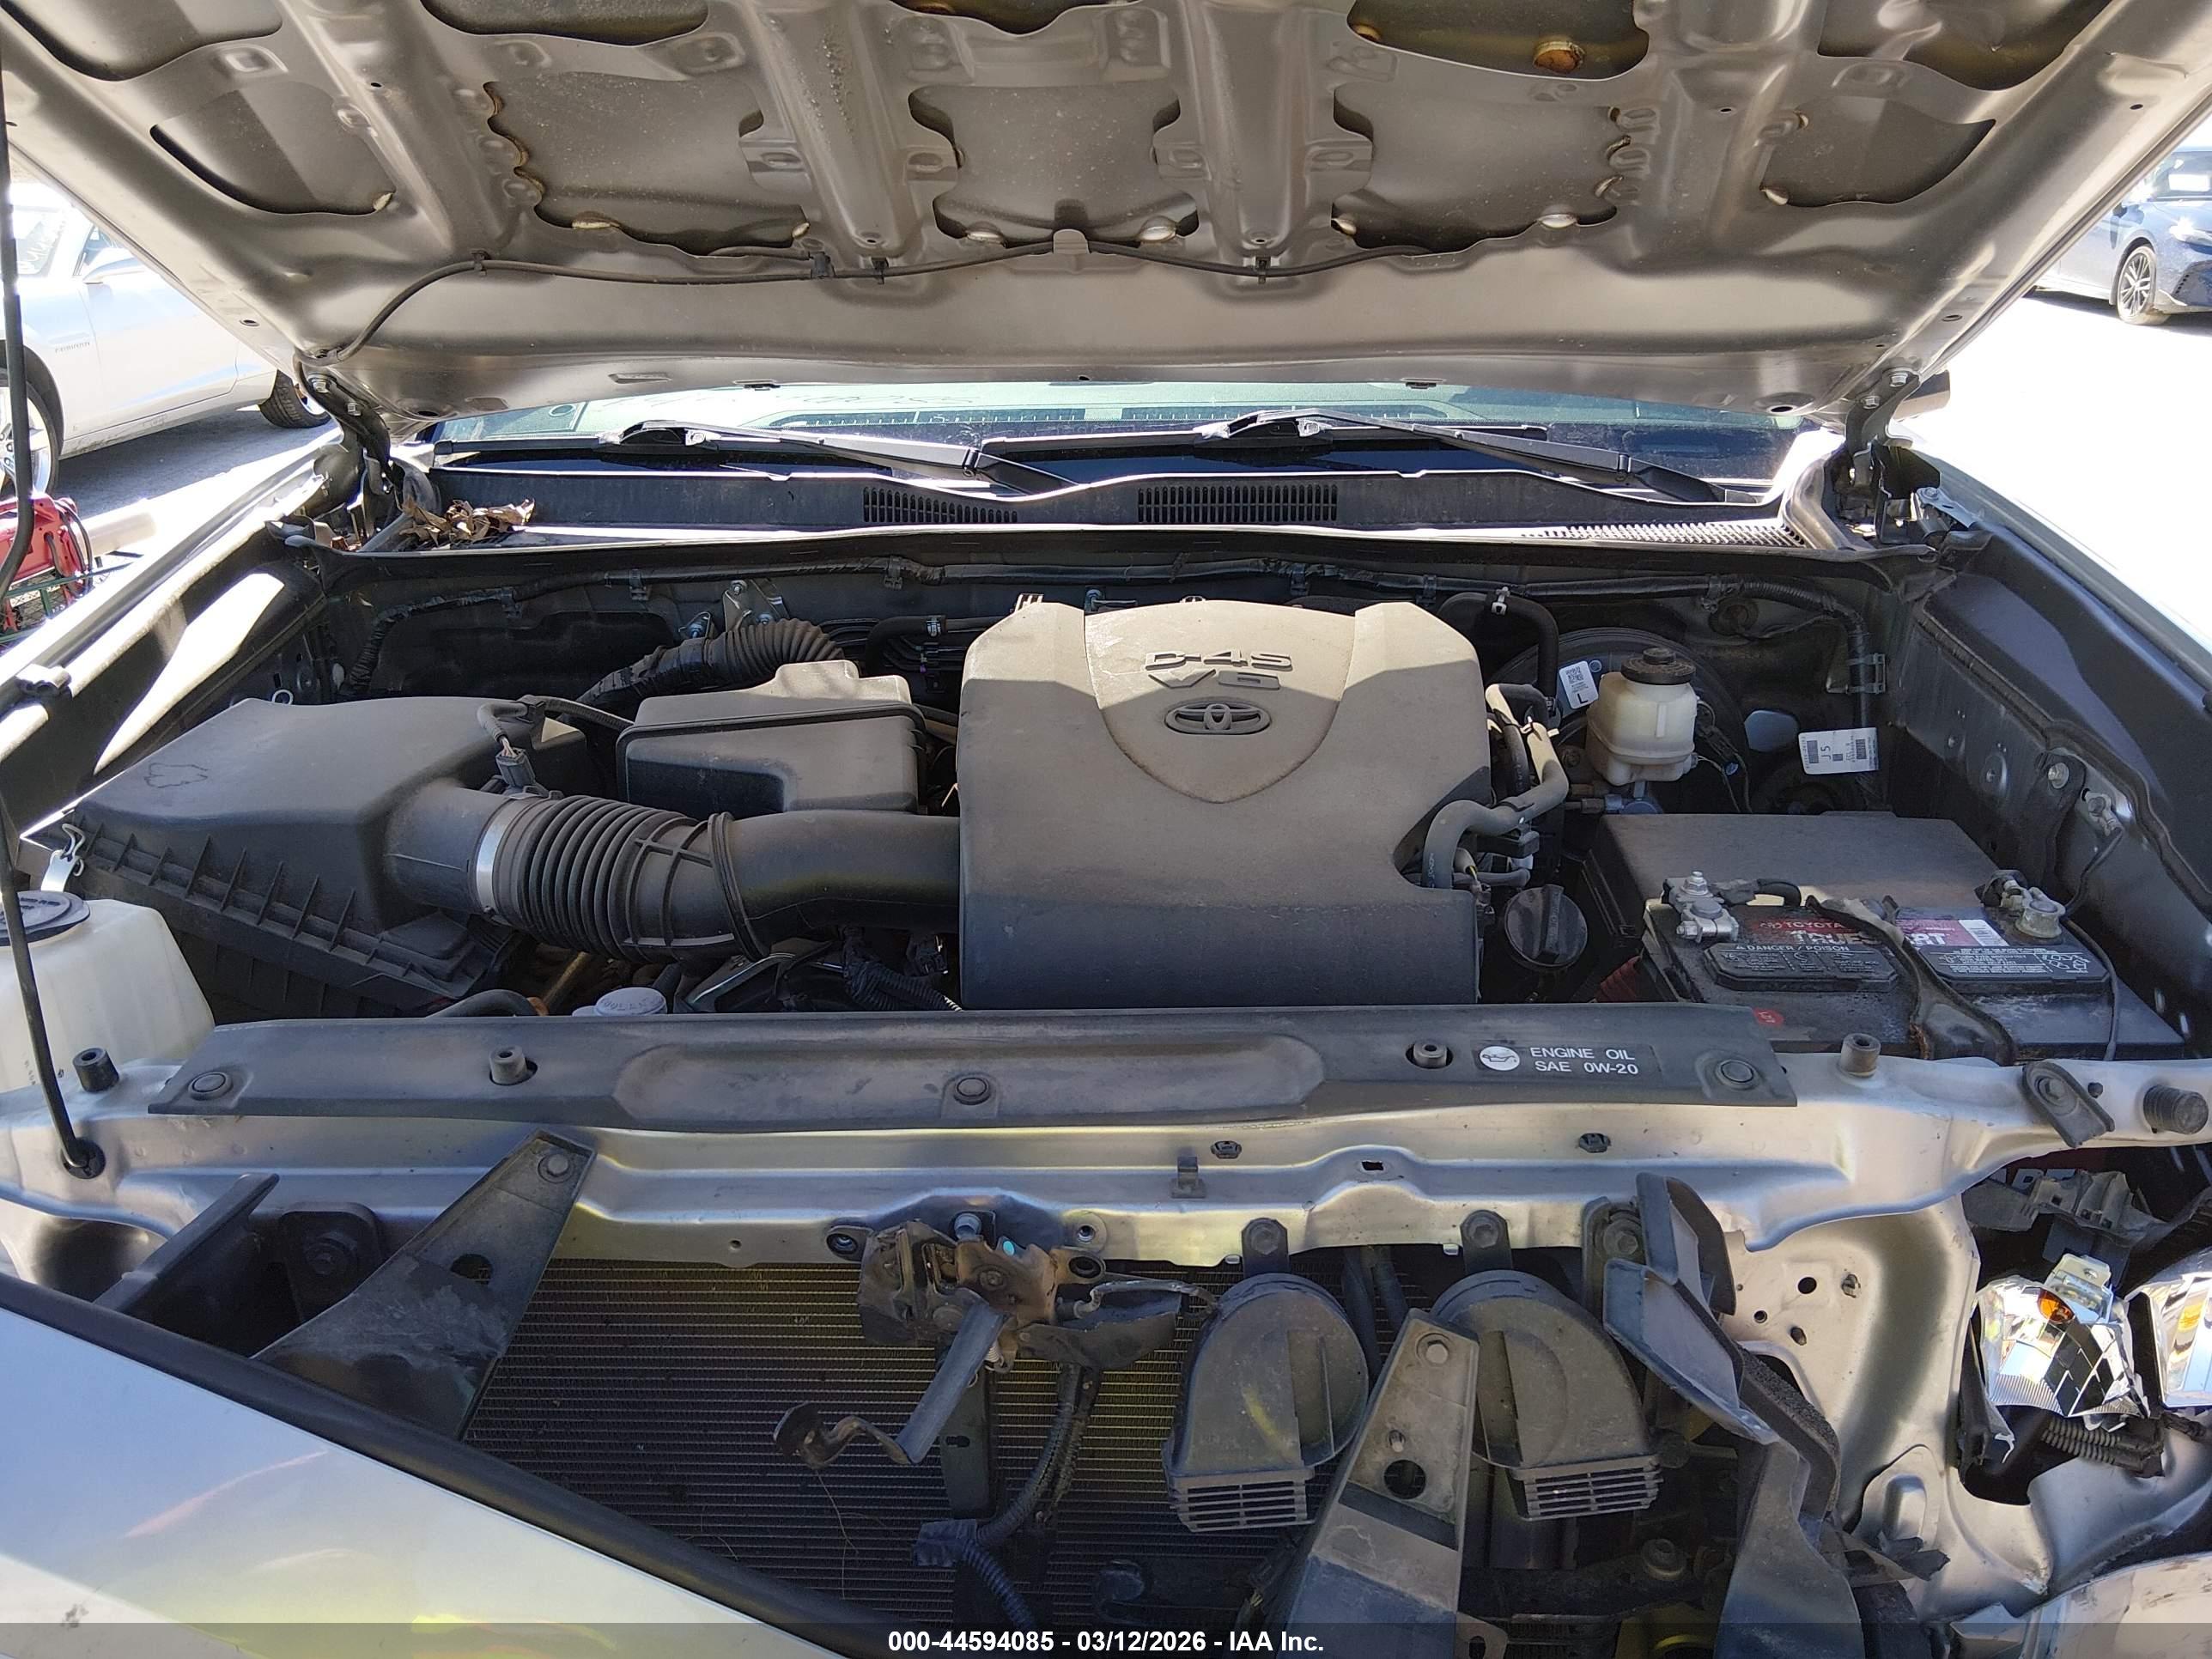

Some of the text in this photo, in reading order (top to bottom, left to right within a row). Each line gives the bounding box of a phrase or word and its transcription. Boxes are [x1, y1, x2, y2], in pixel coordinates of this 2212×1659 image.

[1145, 649, 1293, 672] D-4S
[1148, 668, 1282, 690] V6
[1577, 693, 1589, 704] L
[1529, 1047, 1636, 1060] ENGINE OIL
[1534, 1060, 1639, 1075] SAE 0W-20
